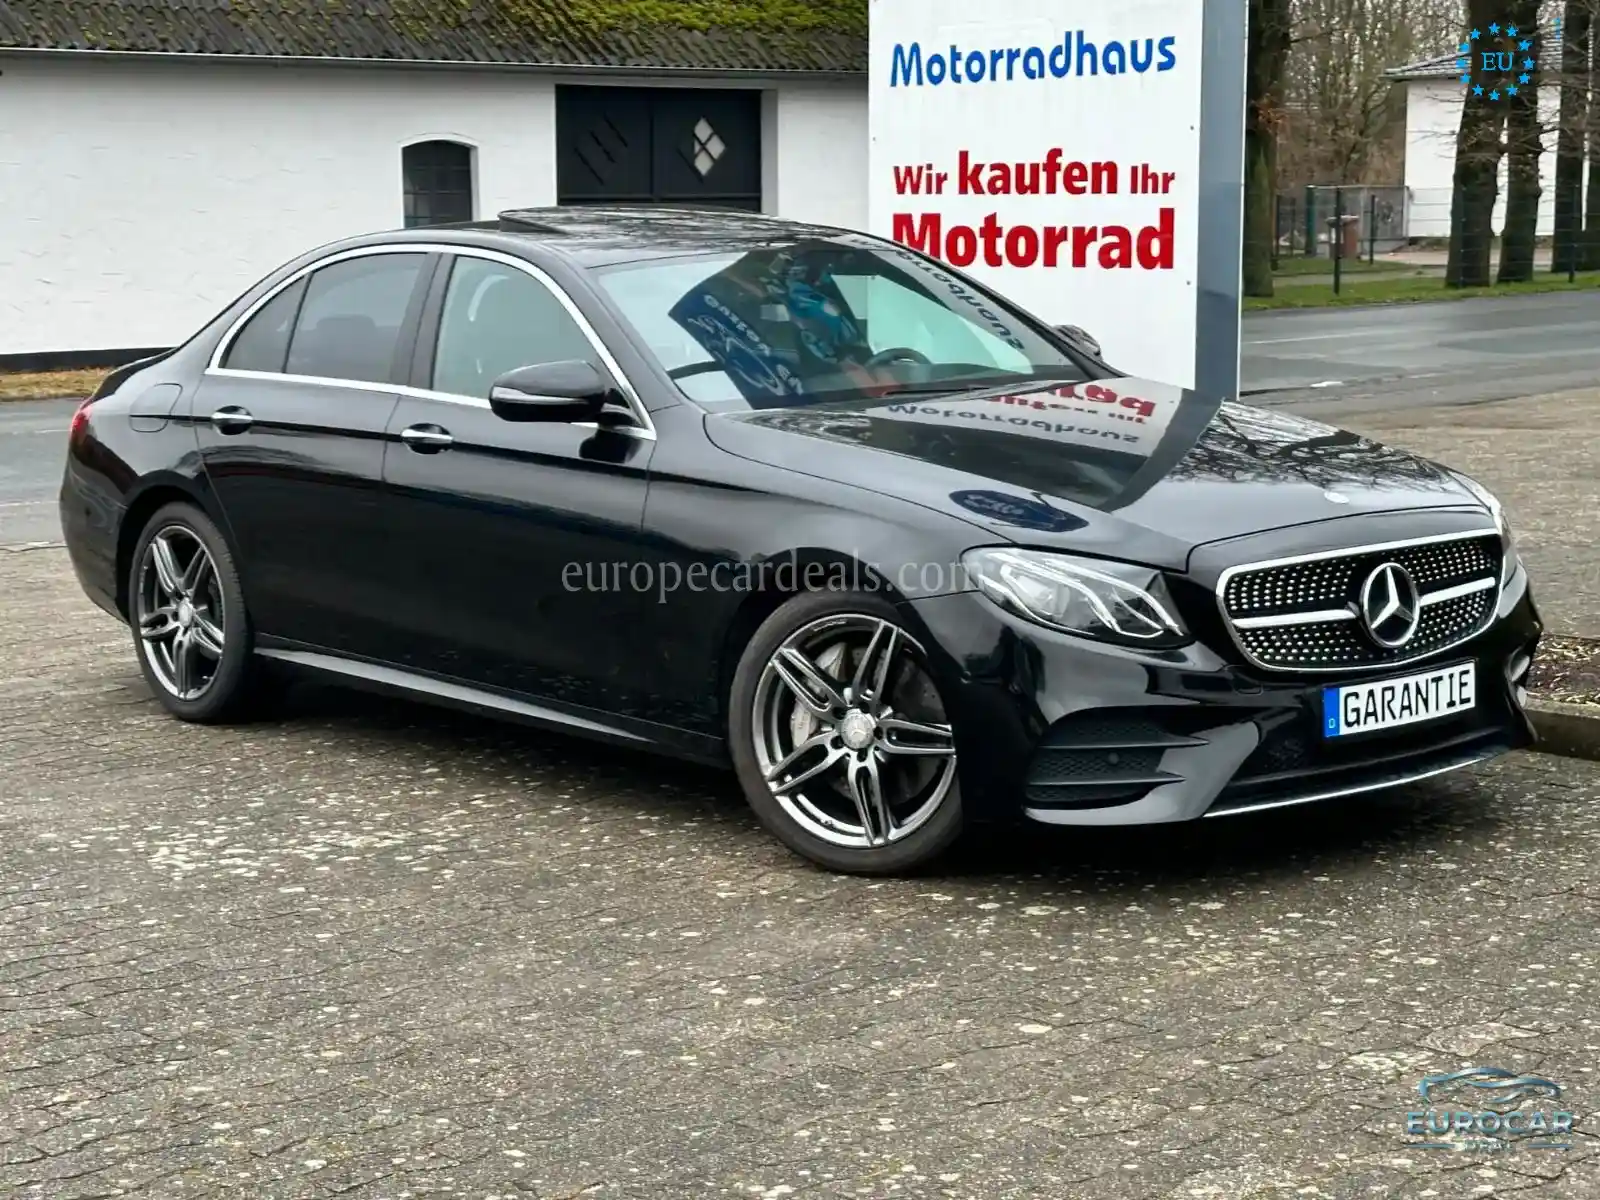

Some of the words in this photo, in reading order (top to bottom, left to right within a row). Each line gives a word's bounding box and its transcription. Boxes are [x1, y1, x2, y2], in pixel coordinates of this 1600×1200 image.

[890, 30, 1176, 87] Motorradhaus
[893, 163, 948, 195] Wir
[958, 148, 1119, 195] kaufen
[1130, 163, 1176, 194] Ihr
[892, 207, 1175, 269] Motorrad
[1344, 669, 1472, 728] GARANTIE
